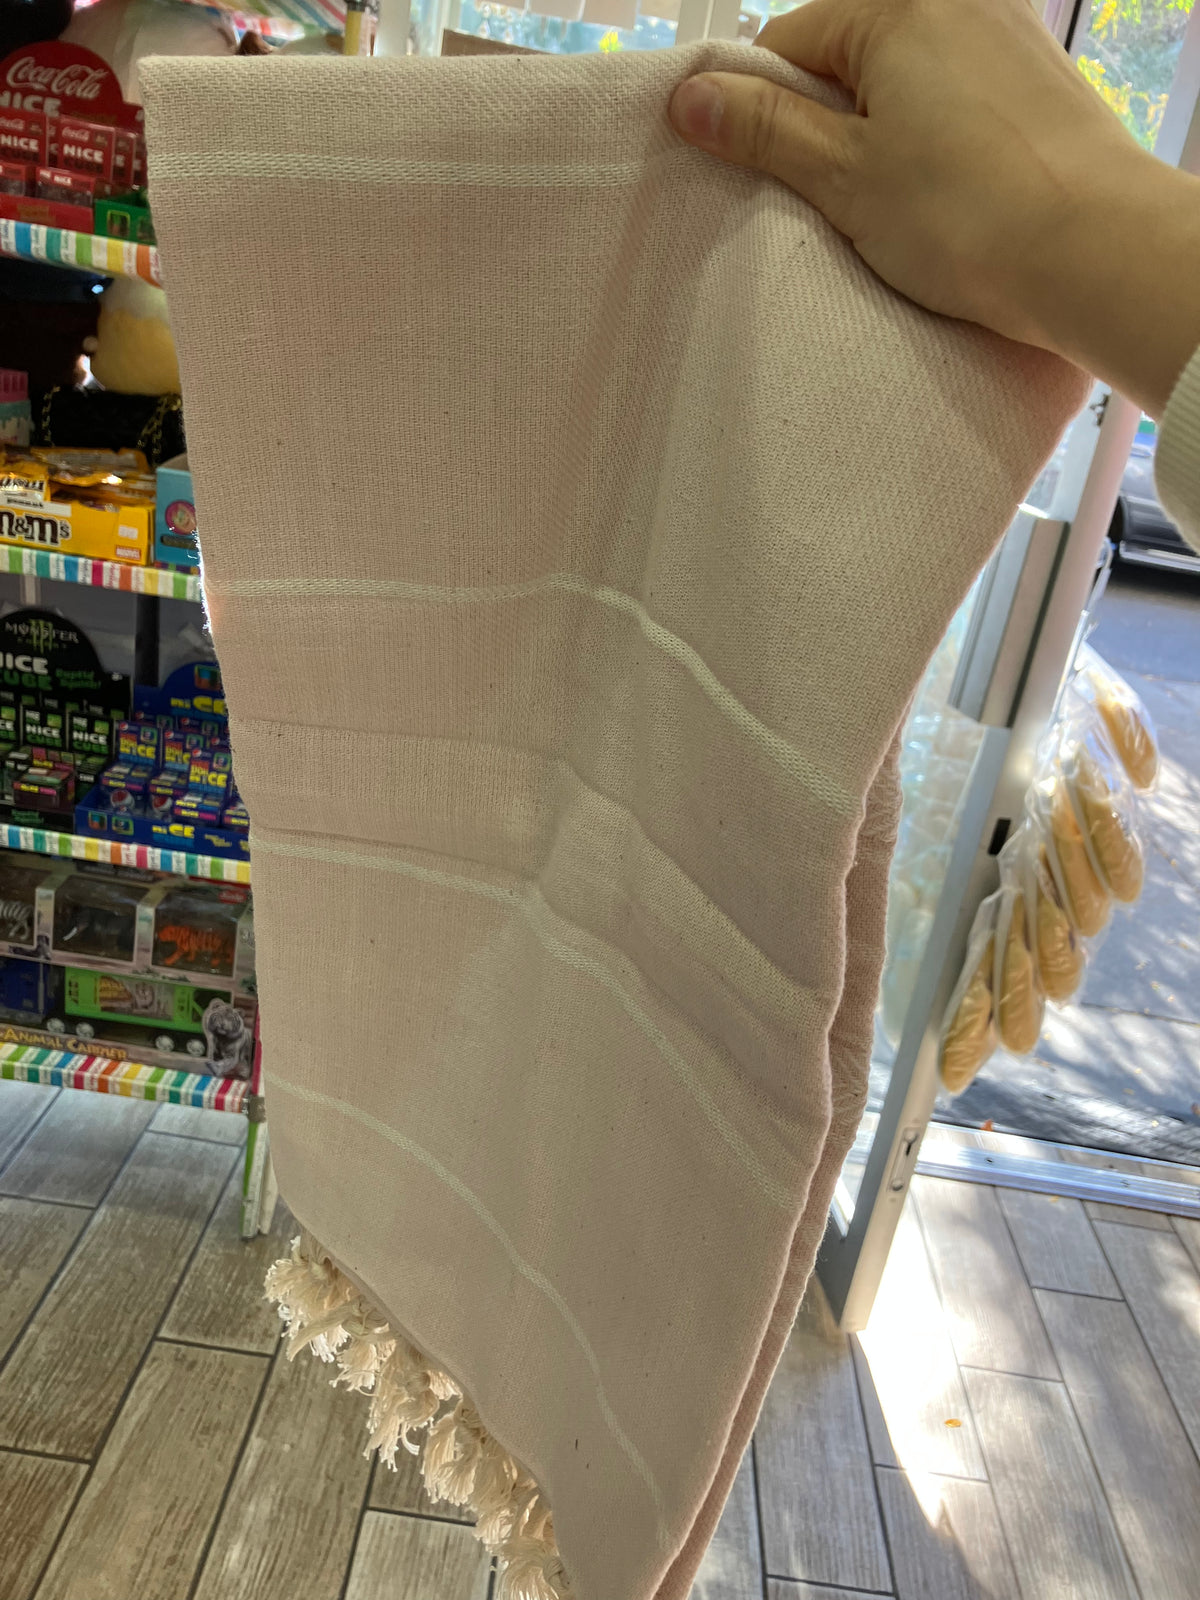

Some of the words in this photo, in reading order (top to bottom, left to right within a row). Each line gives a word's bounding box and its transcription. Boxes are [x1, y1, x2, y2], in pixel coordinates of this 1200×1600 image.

[0, 134, 39, 152] NICE
[63, 144, 104, 163] NICE
[0, 651, 48, 675] ICE
[25, 723, 60, 738] NICE
[72, 730, 107, 745] NICE
